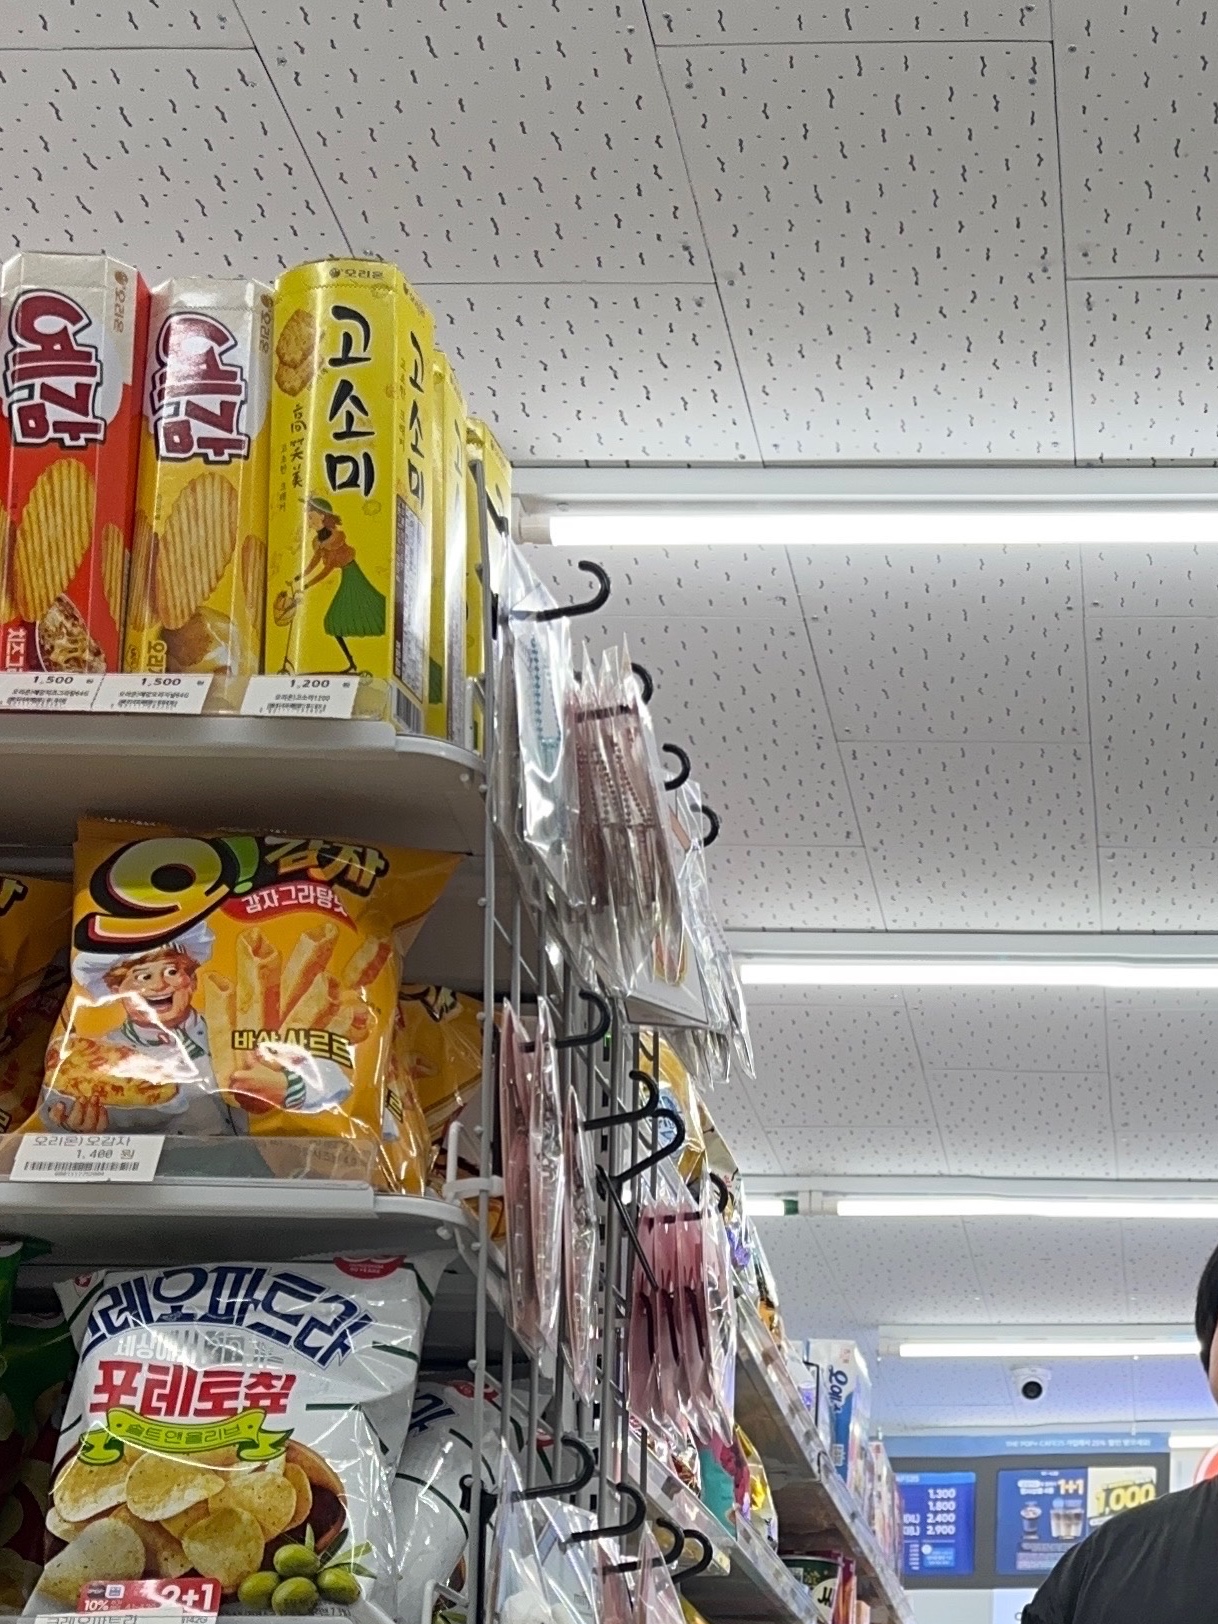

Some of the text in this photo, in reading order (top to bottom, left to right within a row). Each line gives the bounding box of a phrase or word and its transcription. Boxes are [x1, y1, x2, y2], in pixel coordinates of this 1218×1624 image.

[10, 292, 104, 446] 예감
[155, 316, 250, 465] 예감
[325, 304, 376, 498] 고소미
[33, 675, 74, 685] 1,500
[141, 677, 181, 687] 1,500
[290, 679, 330, 689] 1,200
[161, 1584, 213, 1612] 2+1
